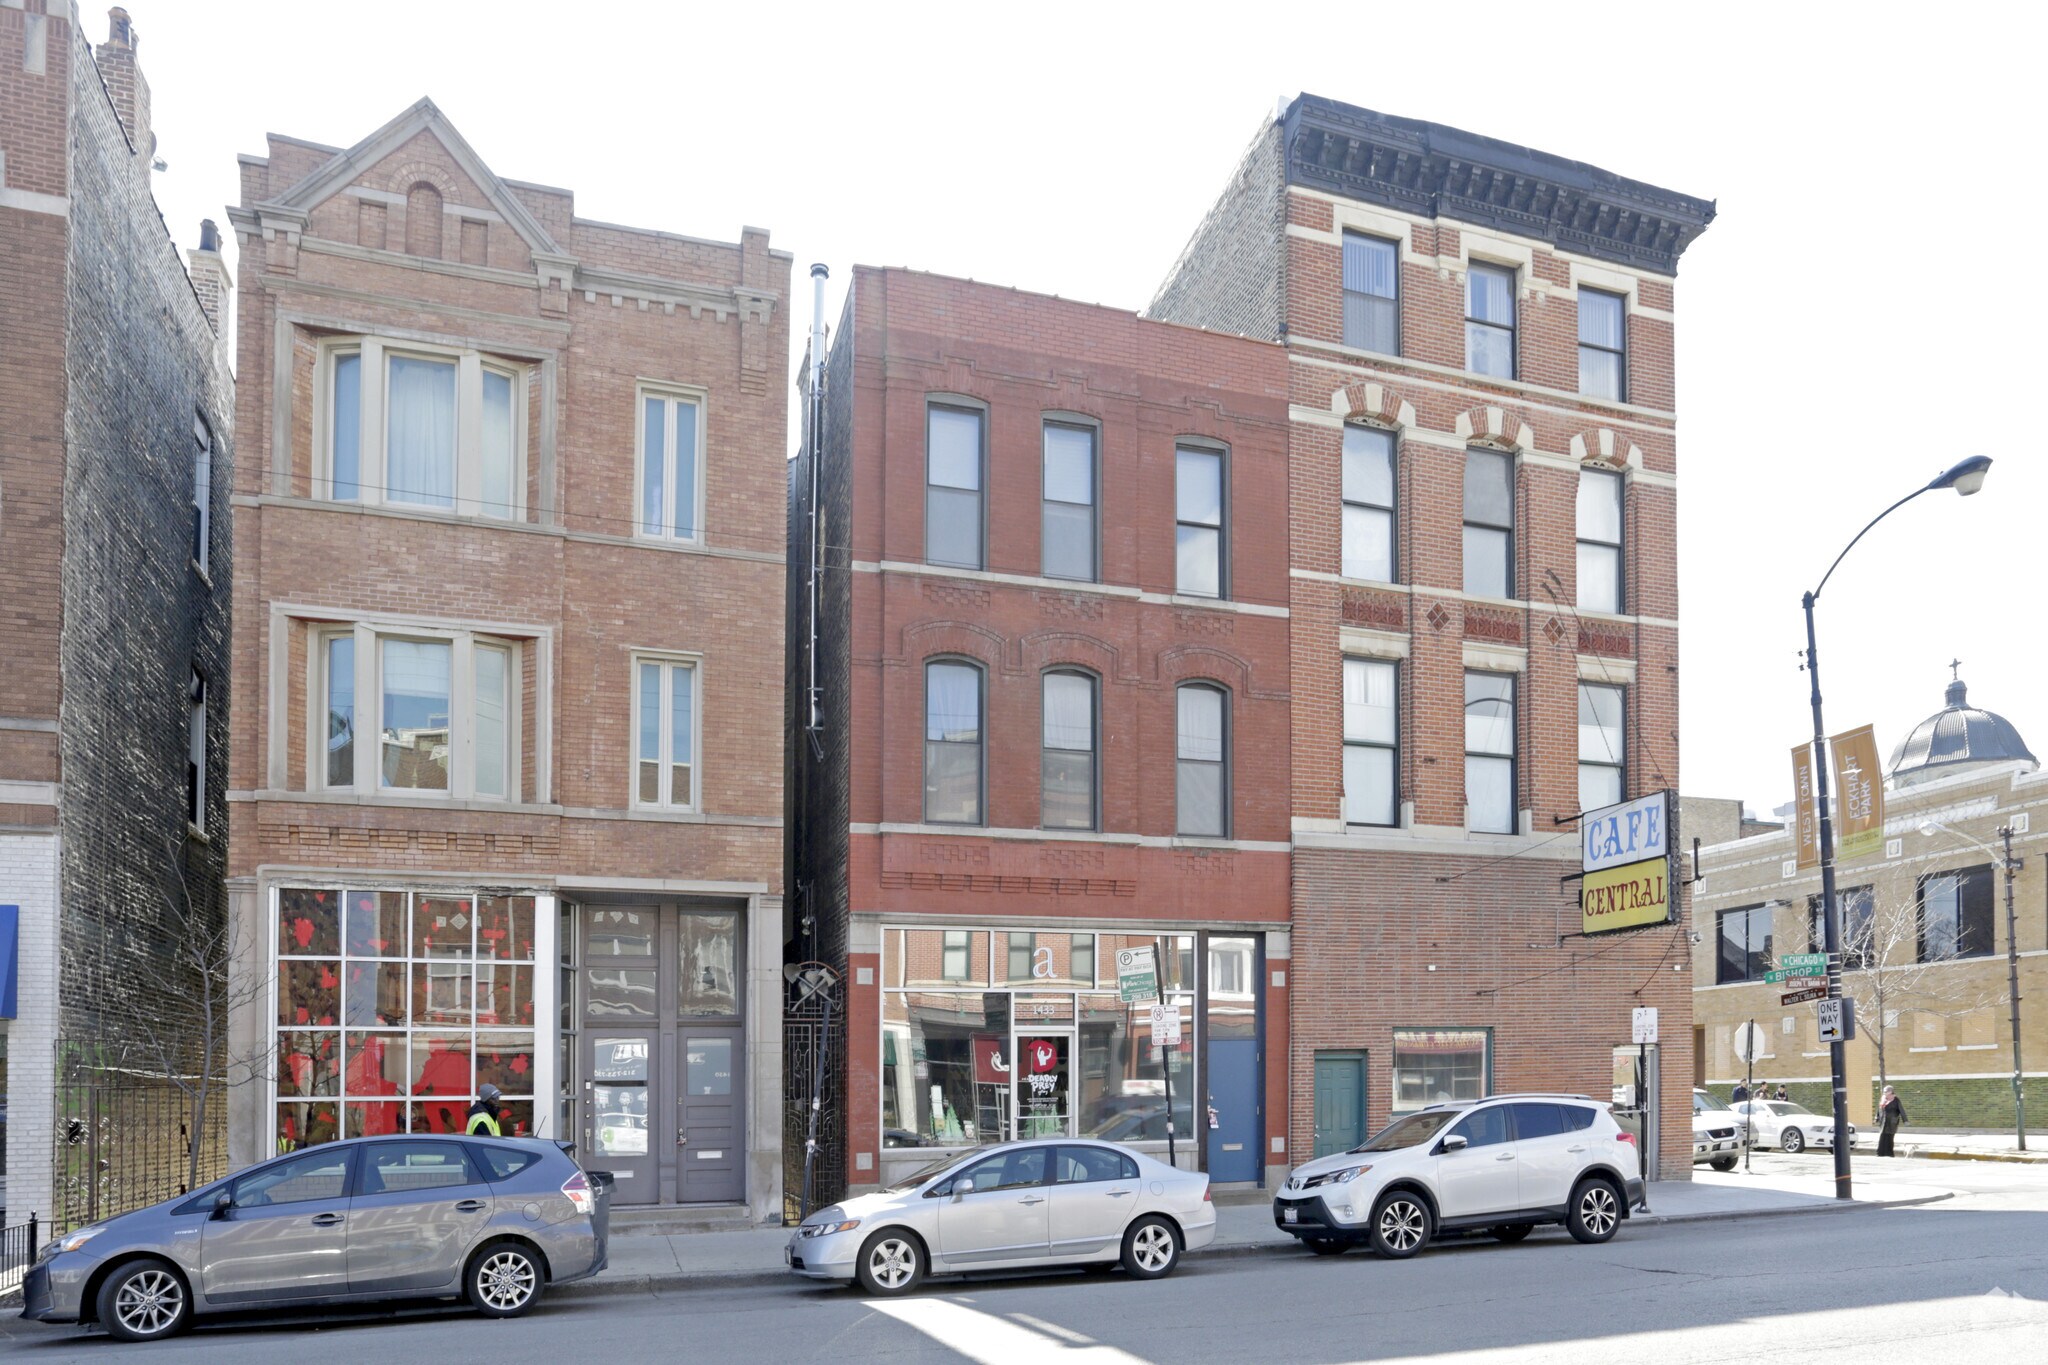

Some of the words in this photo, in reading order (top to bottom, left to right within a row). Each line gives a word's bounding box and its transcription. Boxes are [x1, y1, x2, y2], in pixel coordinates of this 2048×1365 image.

[1798, 765, 1811, 805] TOWN
[1845, 755, 1861, 819] ECKHART
[1860, 779, 1872, 817] PARK
[1588, 804, 1661, 862] CAFE
[1801, 810, 1813, 847] WEST
[1585, 876, 1666, 917] CENTRAL
[1032, 947, 1058, 978] a
[1788, 955, 1818, 966] CHICAGO
[1775, 966, 1813, 981] BISHOP
[1032, 1005, 1055, 1015] 1433
[1820, 1001, 1838, 1014] ONE
[1820, 1013, 1839, 1025] WAY
[1028, 1073, 1058, 1083] DEADLY
[1031, 1081, 1056, 1093] PREY
